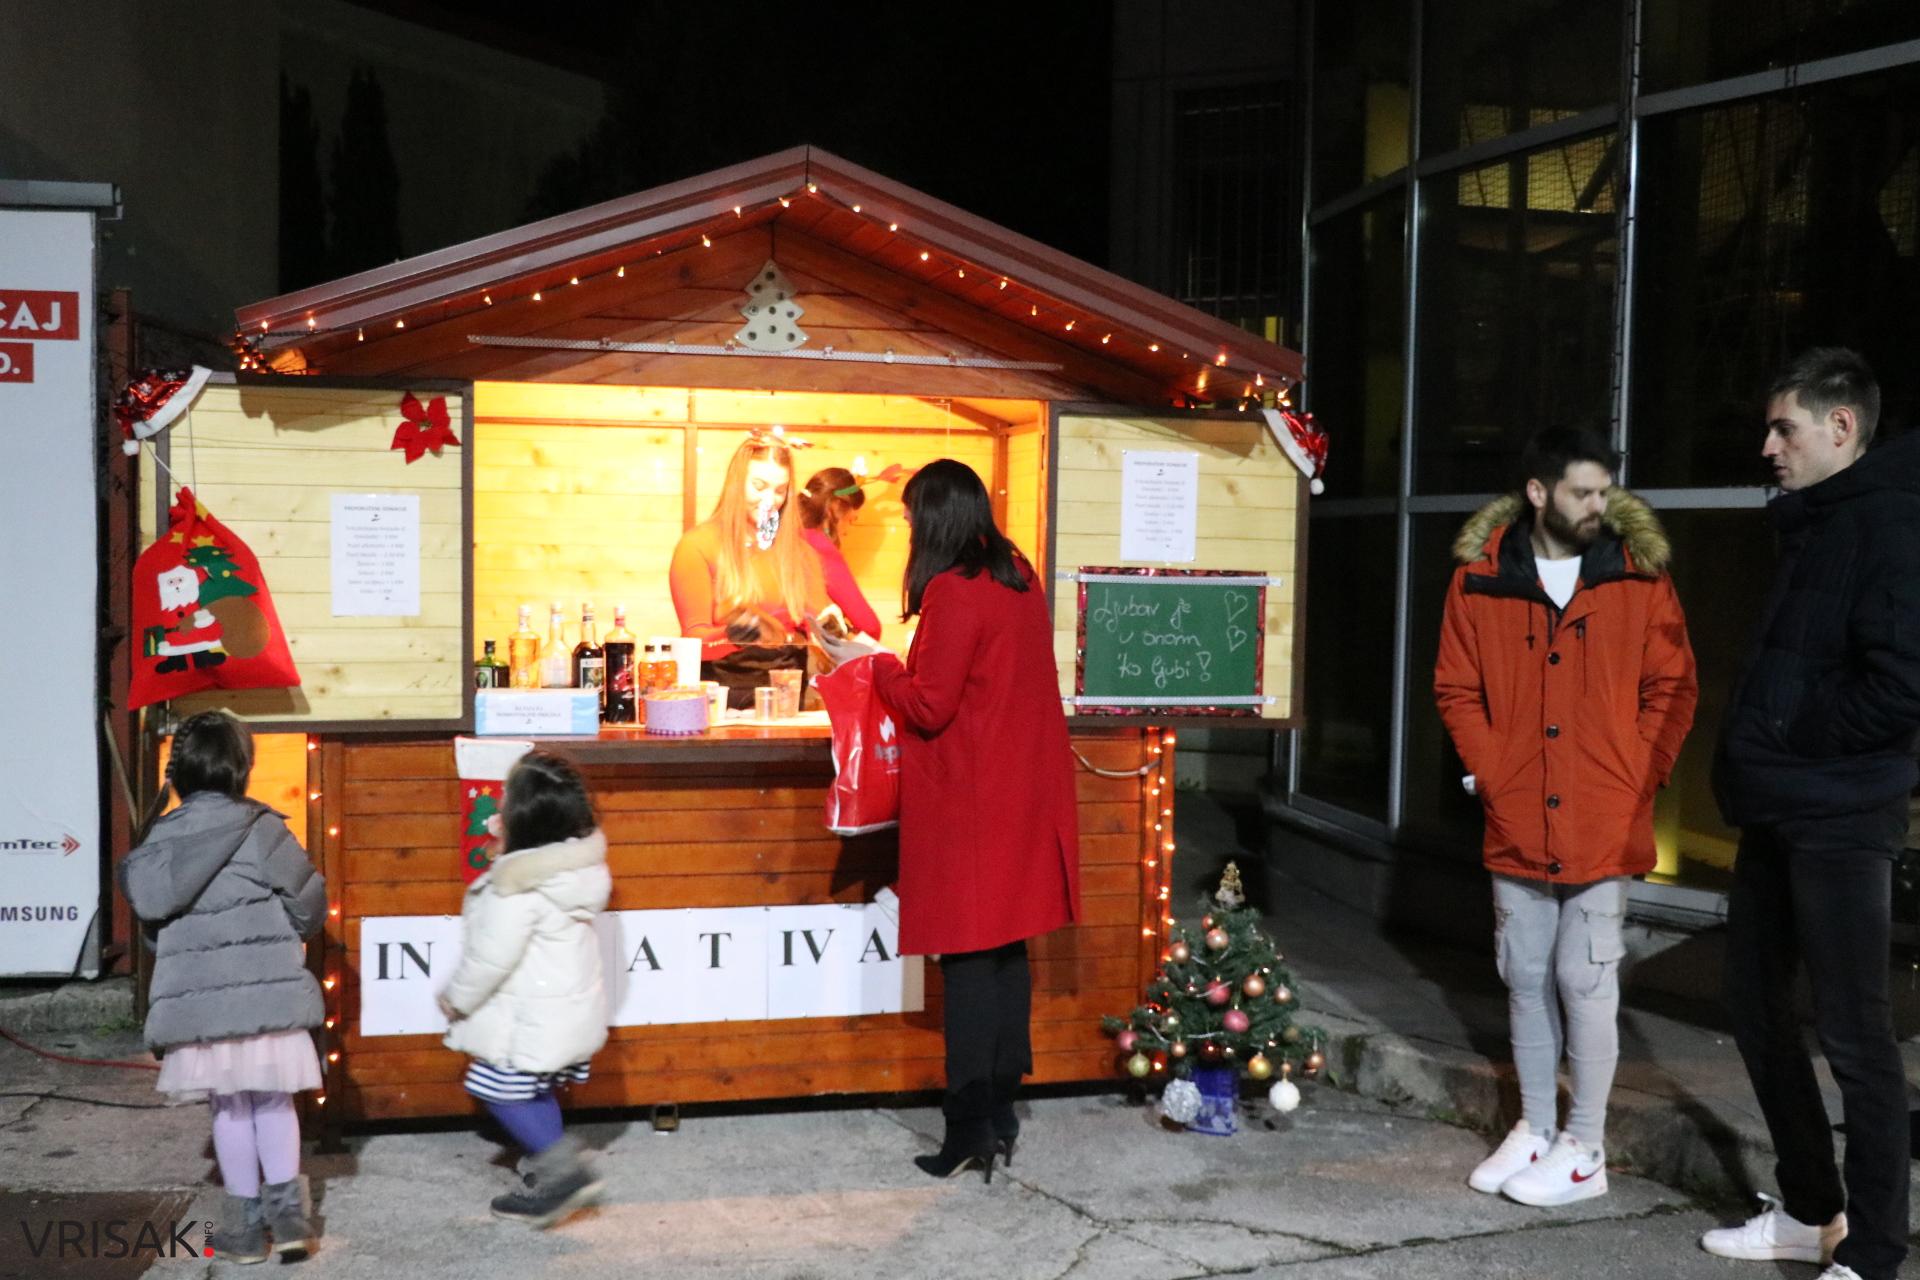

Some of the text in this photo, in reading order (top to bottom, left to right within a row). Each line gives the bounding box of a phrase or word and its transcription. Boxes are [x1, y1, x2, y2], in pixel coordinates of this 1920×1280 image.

[0, 300, 61, 331] AJ
[1170, 598, 1191, 629] je
[1143, 631, 1201, 646] onom
[0, 905, 79, 922] MSUNG
